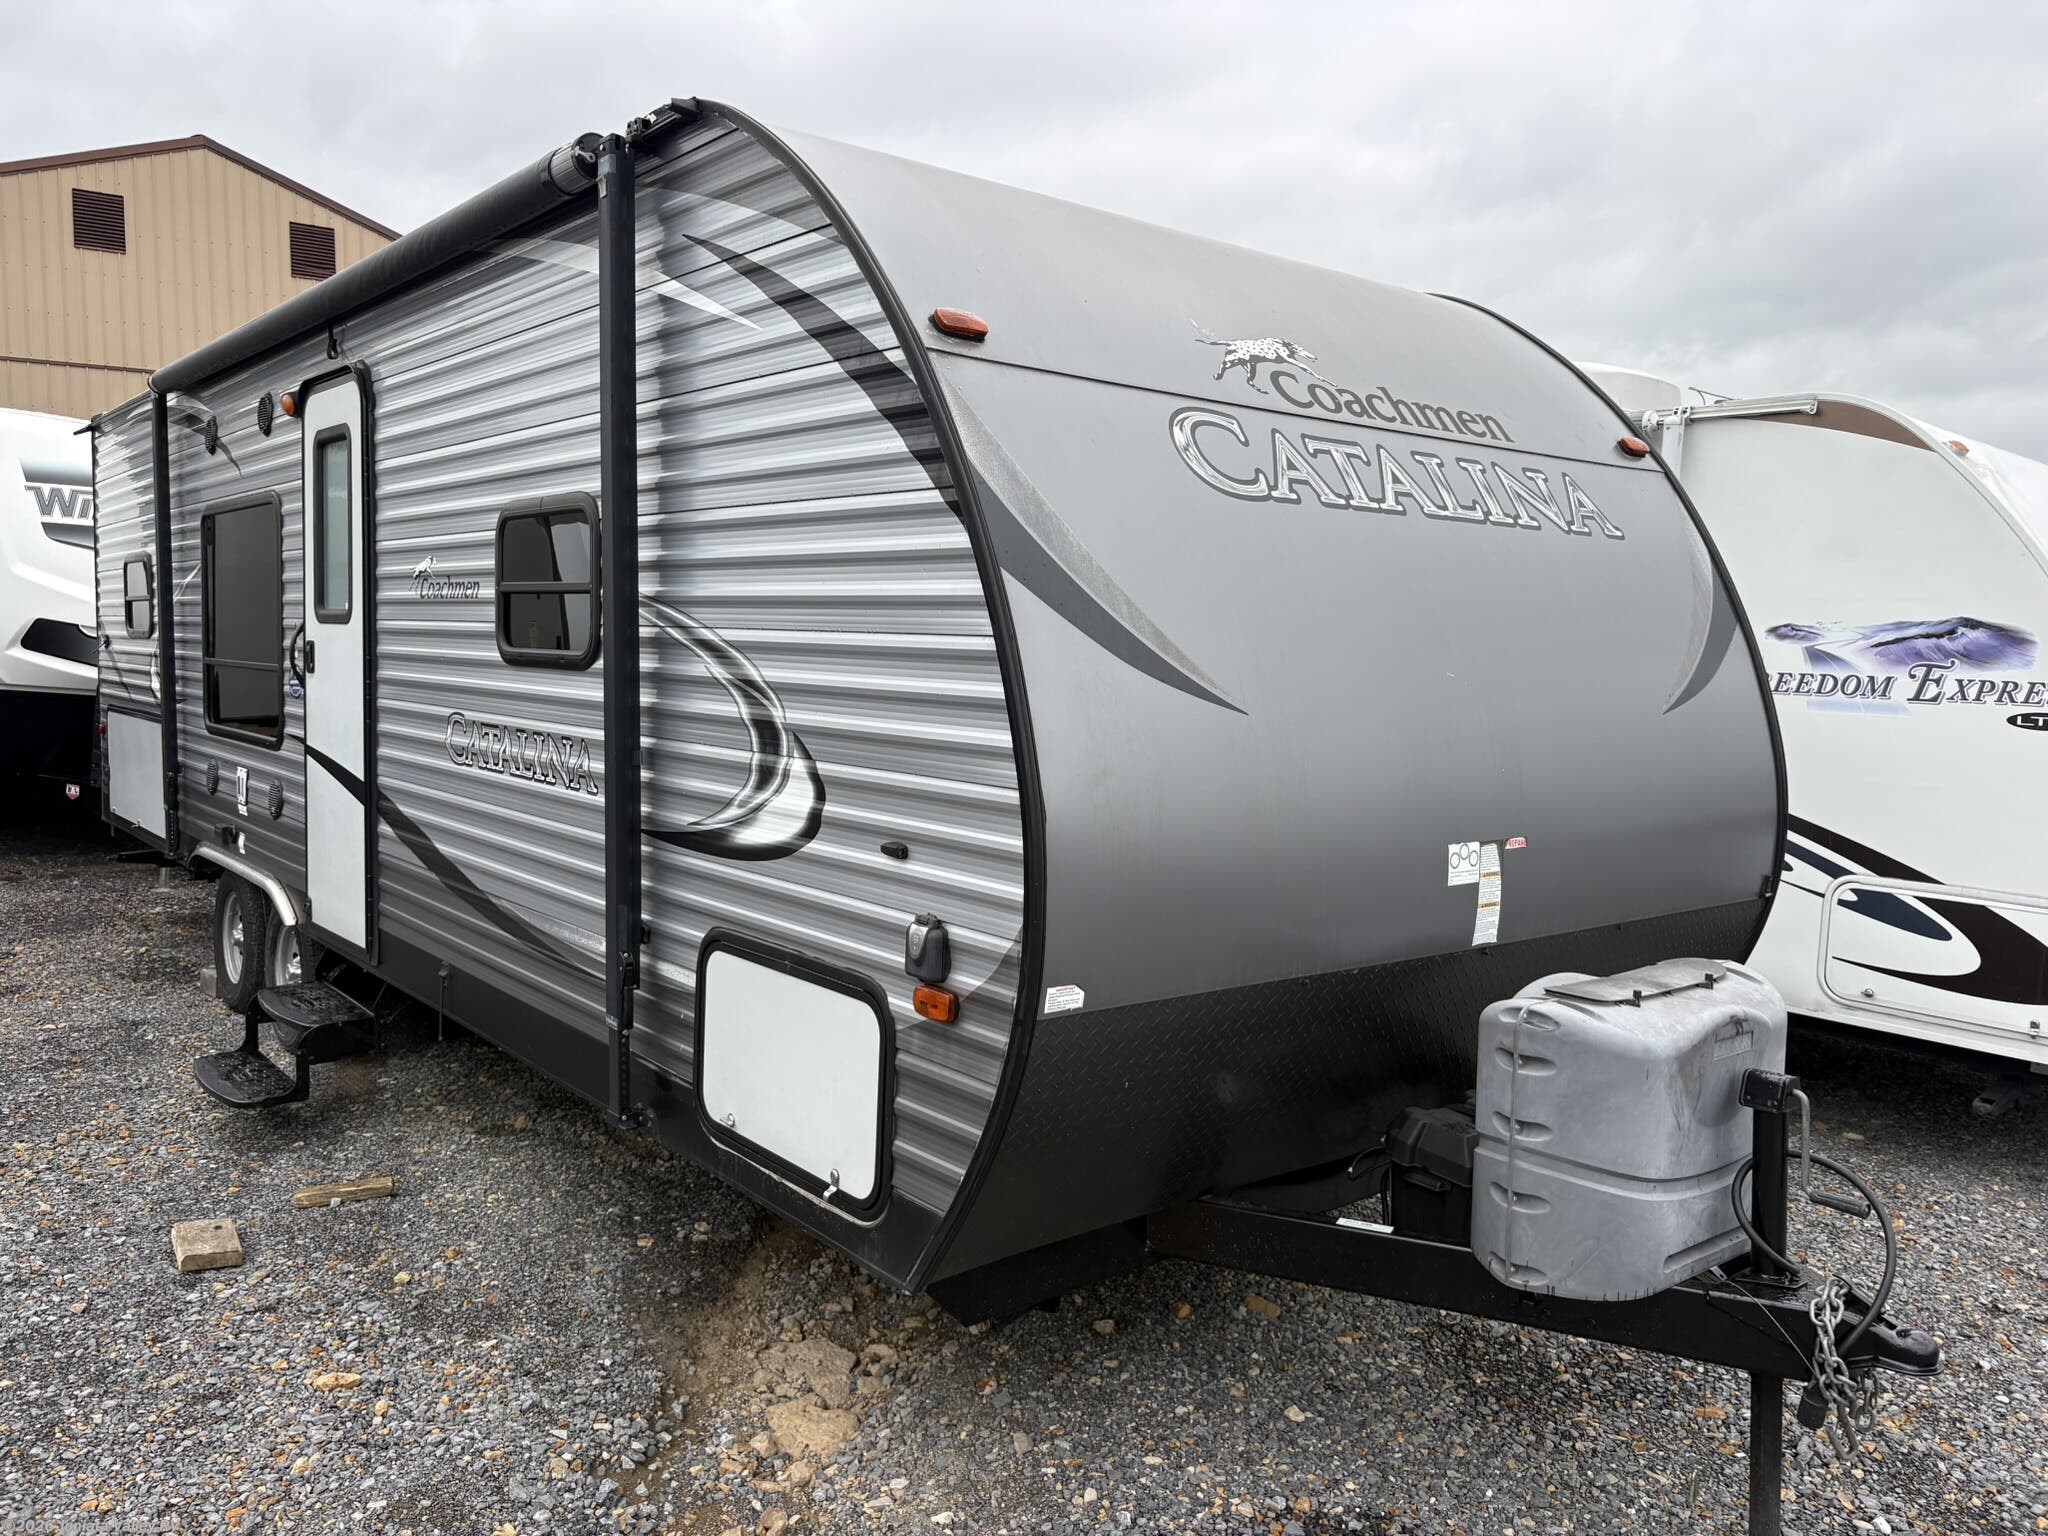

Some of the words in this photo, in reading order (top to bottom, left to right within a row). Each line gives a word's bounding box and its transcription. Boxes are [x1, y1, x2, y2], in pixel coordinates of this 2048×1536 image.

[1270, 370, 1515, 443] Coachmen
[24, 484, 94, 520] WI
[1169, 406, 1625, 541] CATALINA
[420, 575, 480, 600] Coachmen
[1764, 671, 1898, 702] EEDOM
[1906, 658, 2048, 708] EXPRE
[446, 711, 599, 796] CATALINA
